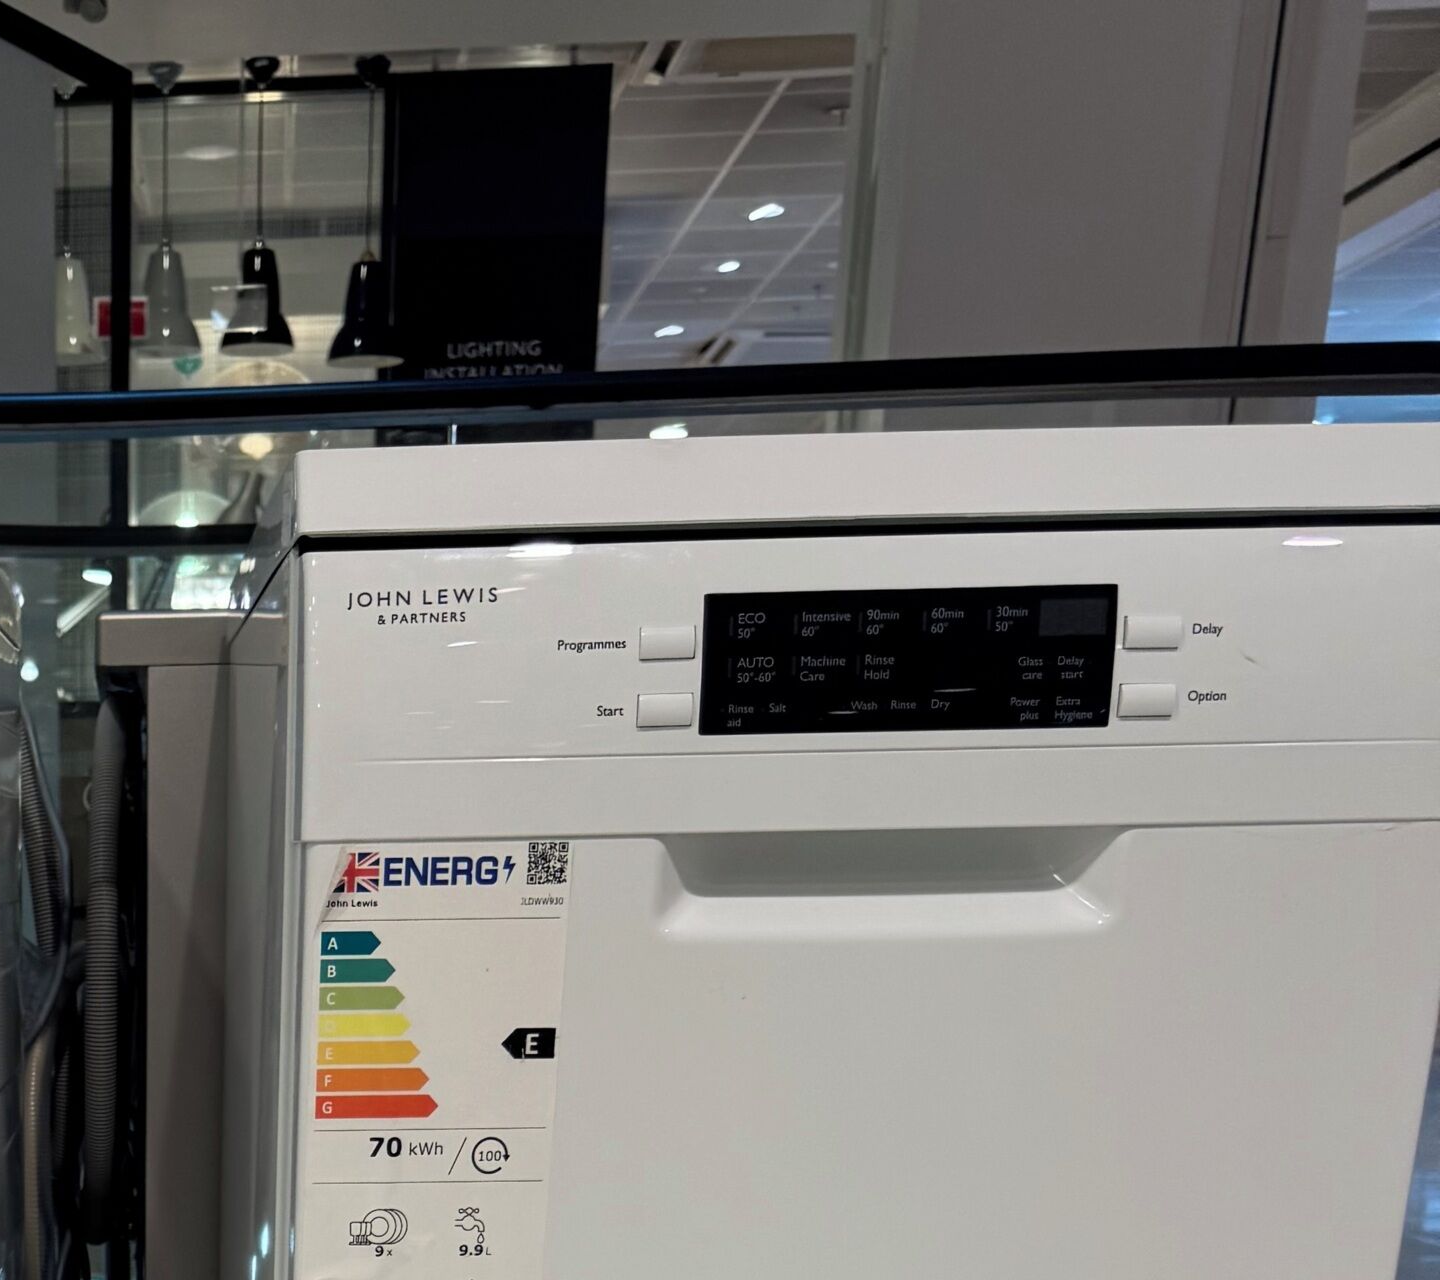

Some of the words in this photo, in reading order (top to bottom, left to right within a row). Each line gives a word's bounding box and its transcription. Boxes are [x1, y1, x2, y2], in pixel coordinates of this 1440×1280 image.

[446, 339, 542, 359] LIGHTING
[347, 590, 411, 611] JOHN
[422, 587, 499, 605] LEWIS
[802, 611, 852, 623] Intensive
[866, 609, 900, 621] 90min
[931, 607, 965, 619] 60min
[996, 605, 1029, 617] 30min
[377, 614, 386, 625] &
[391, 611, 467, 625] PARTNERS
[737, 612, 766, 624] ECO
[1192, 622, 1224, 637] Delay
[557, 639, 627, 653] Programmes
[737, 656, 775, 669] AUTO
[800, 656, 846, 667] Machine
[864, 654, 895, 666] Rinse
[1018, 656, 1044, 667] Glass
[1057, 655, 1085, 667] Delay
[799, 671, 825, 682] Care
[864, 669, 890, 681] Hold
[1022, 671, 1043, 680] care
[1061, 670, 1084, 680] start
[1010, 696, 1041, 707] Power
[1055, 696, 1081, 706] Extra
[1187, 690, 1227, 704] Option
[728, 704, 754, 714] Rinse
[769, 702, 786, 713] Salt
[851, 700, 878, 711] Wash
[890, 700, 917, 710] Rinse
[931, 698, 951, 711] Dry
[596, 705, 624, 717] Start
[1020, 711, 1039, 722] plus
[1054, 709, 1093, 722] Hygiene
[727, 717, 742, 727] aid
[383, 855, 499, 887] ENERG
[326, 899, 348, 908] John
[351, 899, 378, 908] Lewis
[327, 937, 338, 950] A
[327, 965, 337, 978] B
[326, 992, 336, 1005] C
[525, 1033, 539, 1054] E
[325, 1048, 333, 1060] E
[324, 1074, 332, 1087] F
[322, 1101, 333, 1114] G
[369, 1136, 402, 1158] 70
[409, 1142, 444, 1156] kWh
[478, 1150, 502, 1162] 100
[459, 1244, 484, 1256] 9.9
